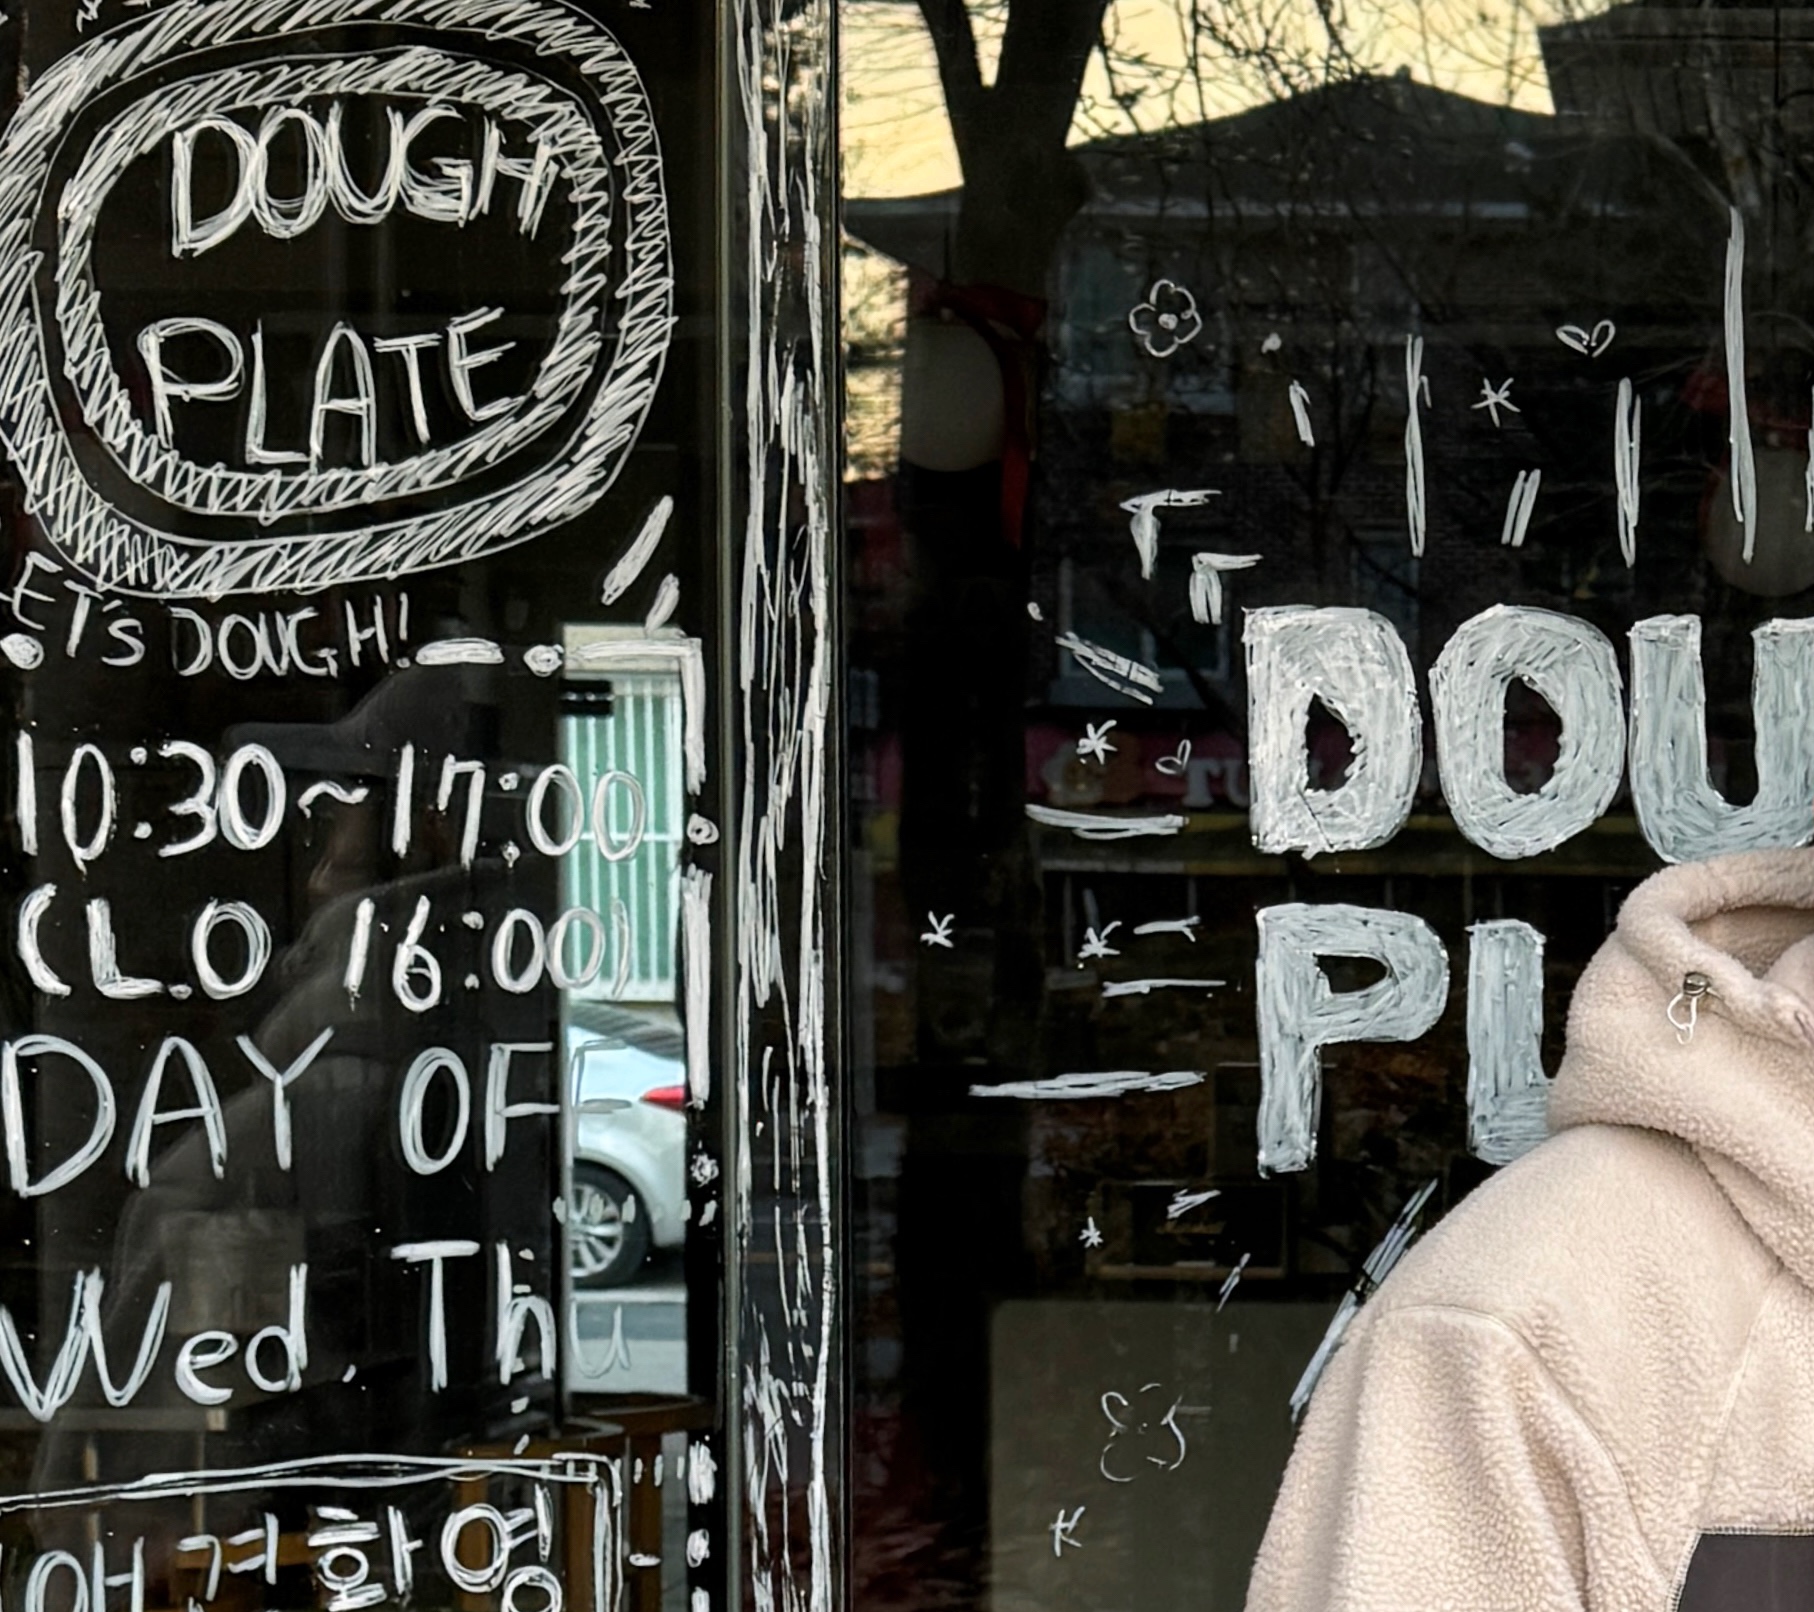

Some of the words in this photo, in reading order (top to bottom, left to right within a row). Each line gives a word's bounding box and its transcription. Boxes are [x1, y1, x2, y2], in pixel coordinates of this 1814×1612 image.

[172, 100, 556, 258] DOUGH
[137, 306, 518, 472] PLATE
[2, 1026, 334, 1199] DAY
[400, 1038, 632, 1177] OFF
[391, 1238, 632, 1393] Thu
